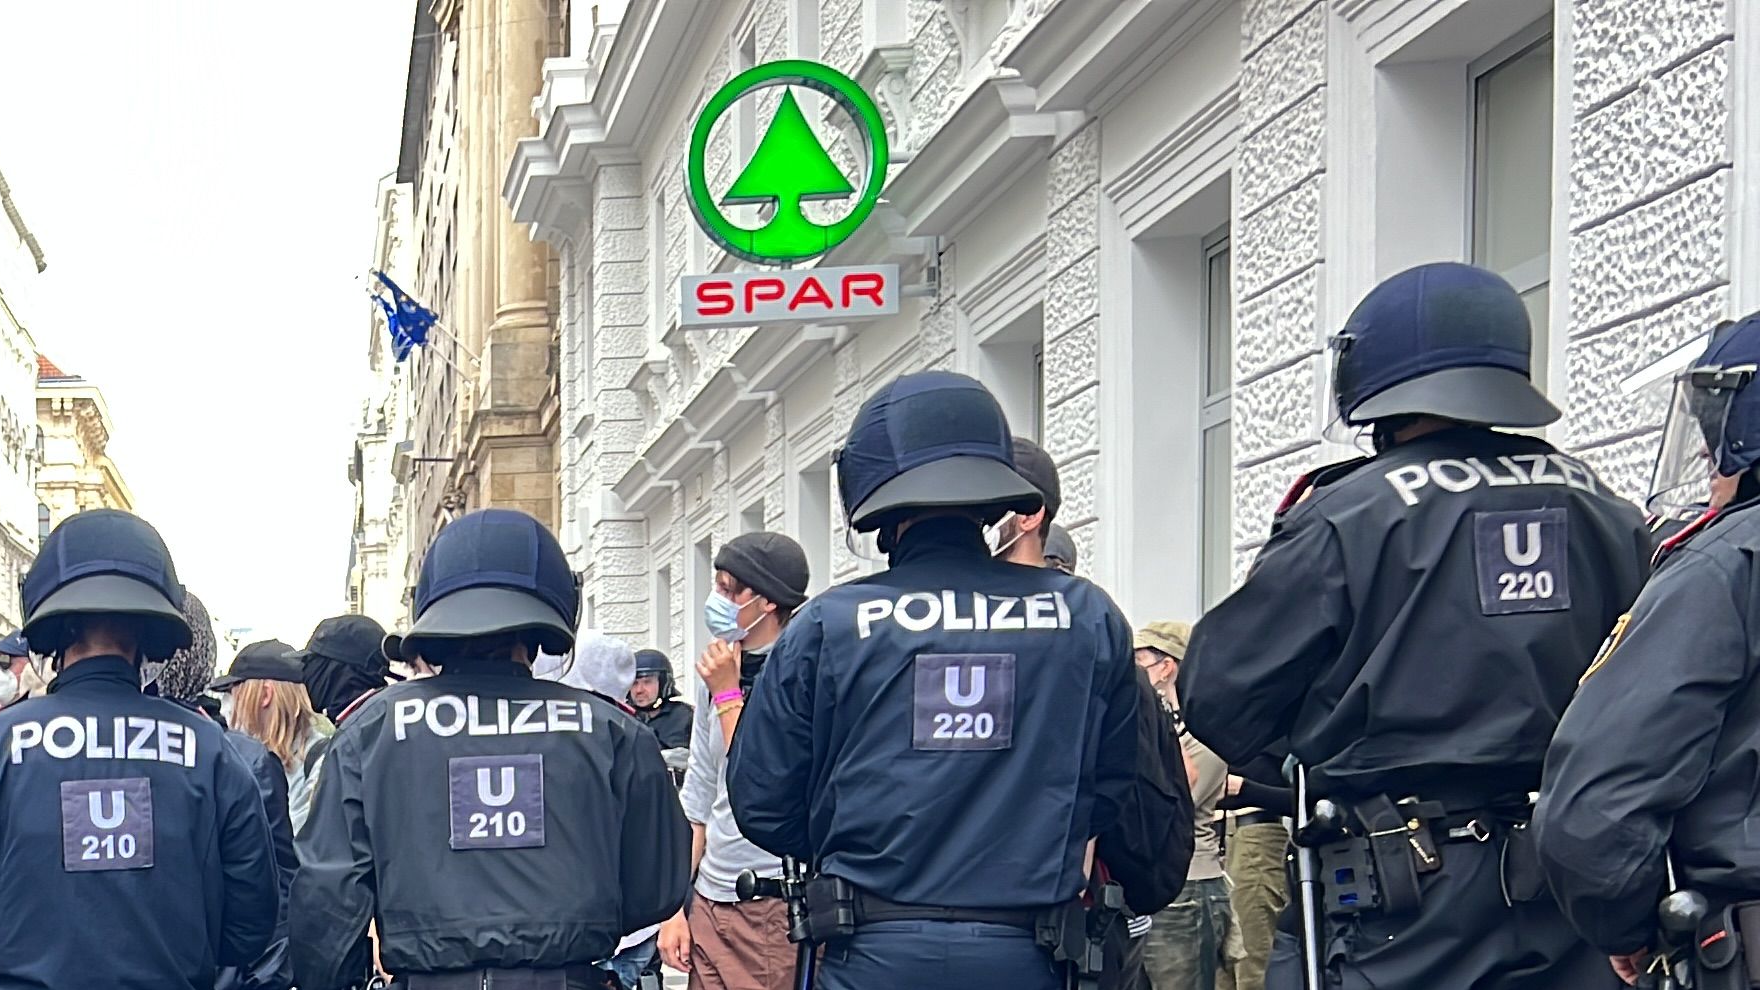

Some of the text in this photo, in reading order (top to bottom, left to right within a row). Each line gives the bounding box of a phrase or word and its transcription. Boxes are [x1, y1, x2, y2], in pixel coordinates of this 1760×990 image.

[696, 272, 886, 317] SPAR
[1502, 522, 1542, 567] U
[1498, 570, 1555, 601] 220
[856, 590, 1072, 640] POLIZEI
[944, 666, 986, 707] U
[394, 694, 593, 742] POLIZEI
[932, 713, 994, 740] 220
[10, 715, 198, 768] POLIZEI
[476, 766, 515, 807] U
[88, 790, 126, 829] U
[469, 810, 526, 838] 210
[81, 833, 136, 861] 210
